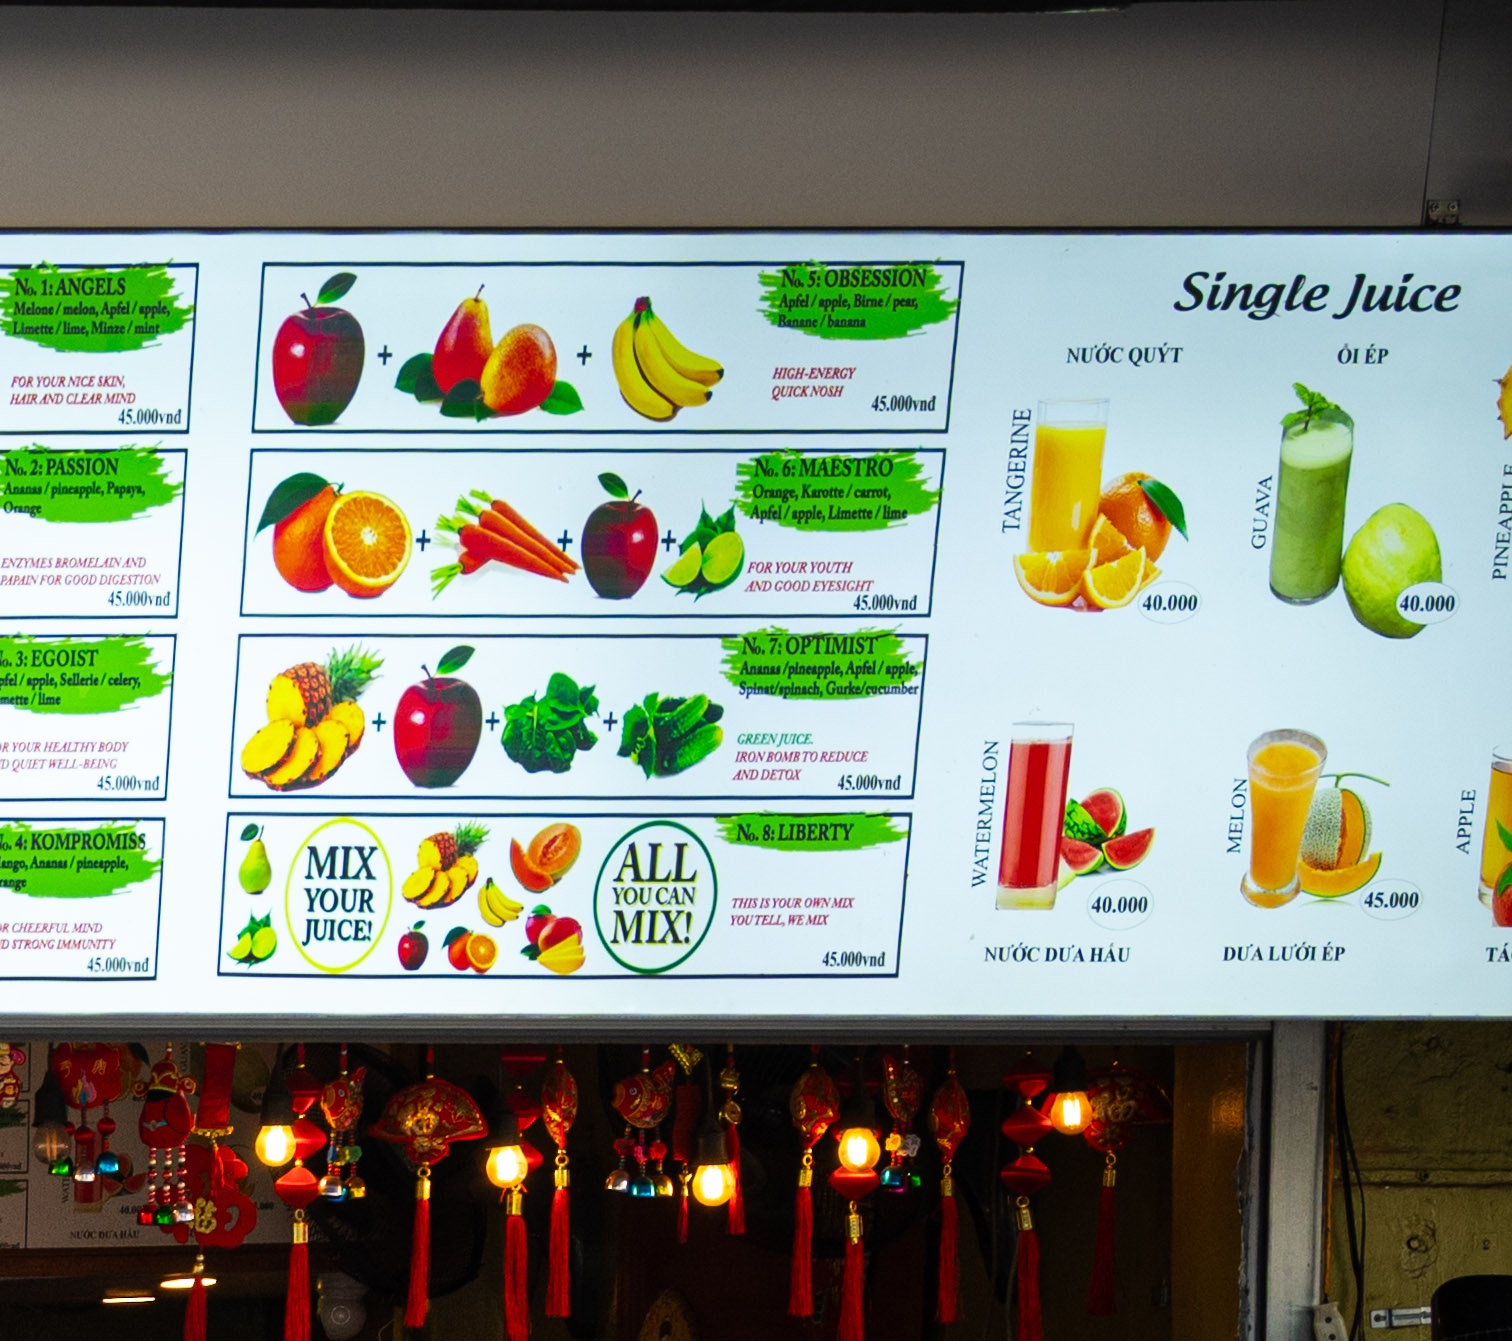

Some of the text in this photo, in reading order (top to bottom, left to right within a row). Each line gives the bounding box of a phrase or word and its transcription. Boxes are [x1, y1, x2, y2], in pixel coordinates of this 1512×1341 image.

[41, 279, 53, 295] 1:
[55, 277, 126, 296] ANGELS
[808, 269, 821, 288] 5:
[824, 268, 927, 288] OBSESSION
[1173, 271, 1462, 320] Single Juice
[1066, 343, 1183, 367] NƯỚC QUÝT
[1362, 343, 1389, 366] ÉP
[30, 459, 43, 476] 2:
[46, 457, 119, 476] PASSION
[782, 459, 796, 477] 6:
[798, 458, 894, 477] MAESTRO
[1002, 407, 1033, 534] TANGERINE
[1251, 473, 1274, 550] GUAVA
[1142, 592, 1199, 615] 40.000
[1399, 592, 1457, 615] 40.000
[971, 740, 999, 888] WATERMELON
[1226, 777, 1249, 854] MELON
[14, 834, 28, 851] 4:
[31, 832, 146, 851] KOMPROMISS
[763, 824, 775, 842] 8:
[778, 823, 854, 842] LIBERTY
[305, 845, 379, 880] MIX
[613, 842, 697, 884] ALL
[304, 887, 375, 914] YOUR
[612, 886, 696, 906] YOU CAN
[302, 918, 373, 947] JUICE!
[610, 910, 693, 946] MIX!
[984, 942, 1042, 963] NƯỚC
